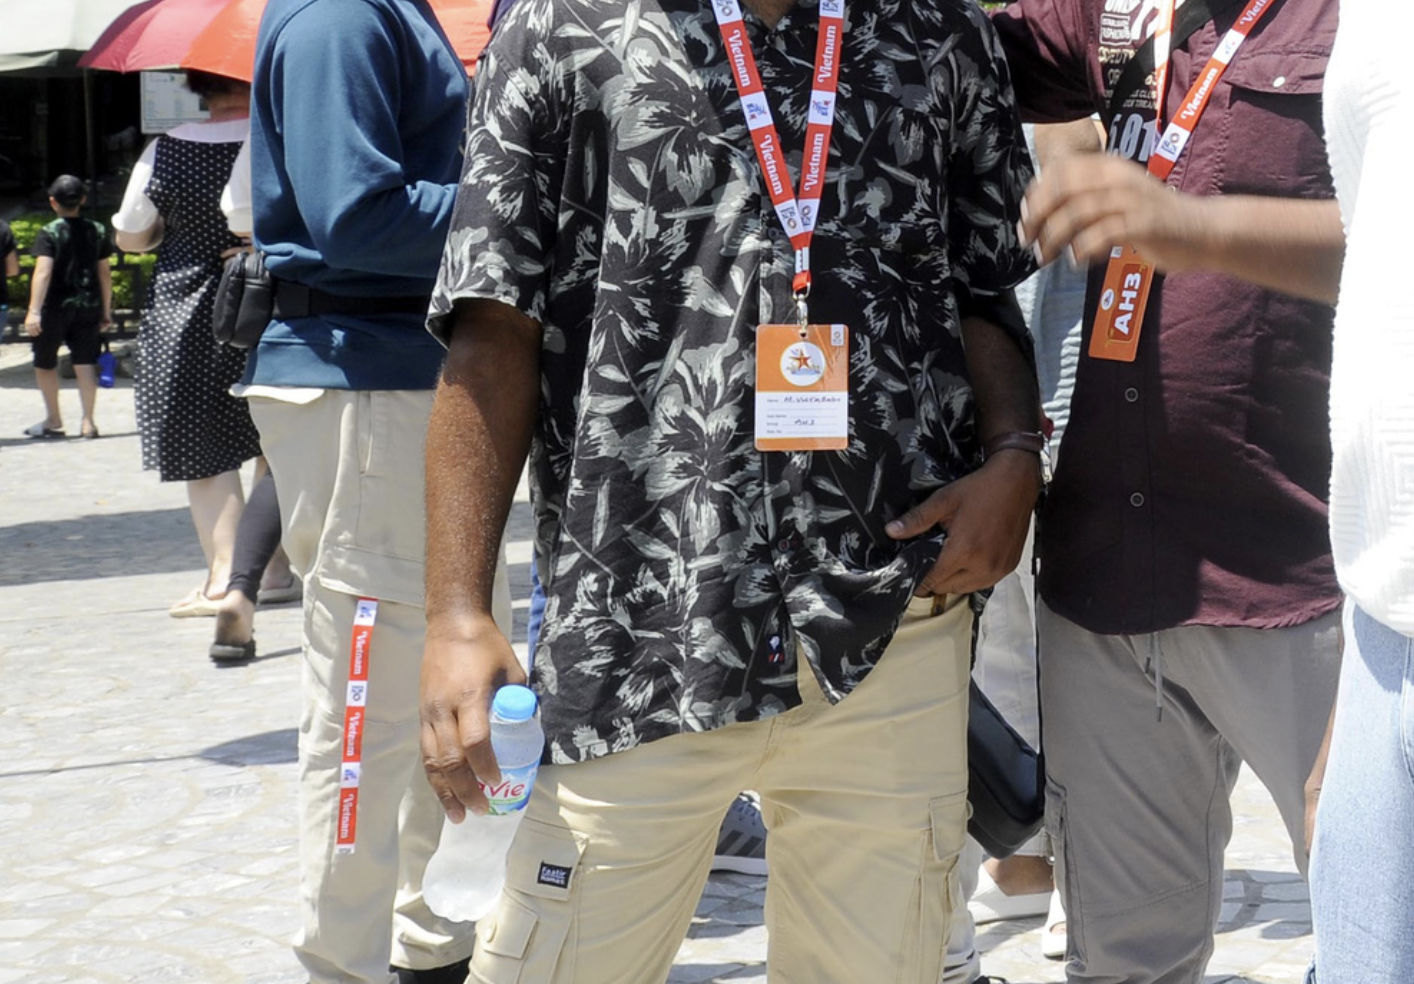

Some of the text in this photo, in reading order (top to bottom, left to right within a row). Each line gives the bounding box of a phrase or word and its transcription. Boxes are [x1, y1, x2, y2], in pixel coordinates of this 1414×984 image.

[728, 29, 751, 87] Vietnam
[816, 25, 837, 83] Vietnam
[1180, 67, 1219, 120] Vietnam
[760, 134, 783, 196] Vietnam
[803, 133, 825, 192] Vietnam
[1114, 272, 1142, 335] AH3
[353, 631, 369, 675] Vietnam
[346, 711, 361, 756] Vietnam
[340, 793, 355, 839] Vietnam
